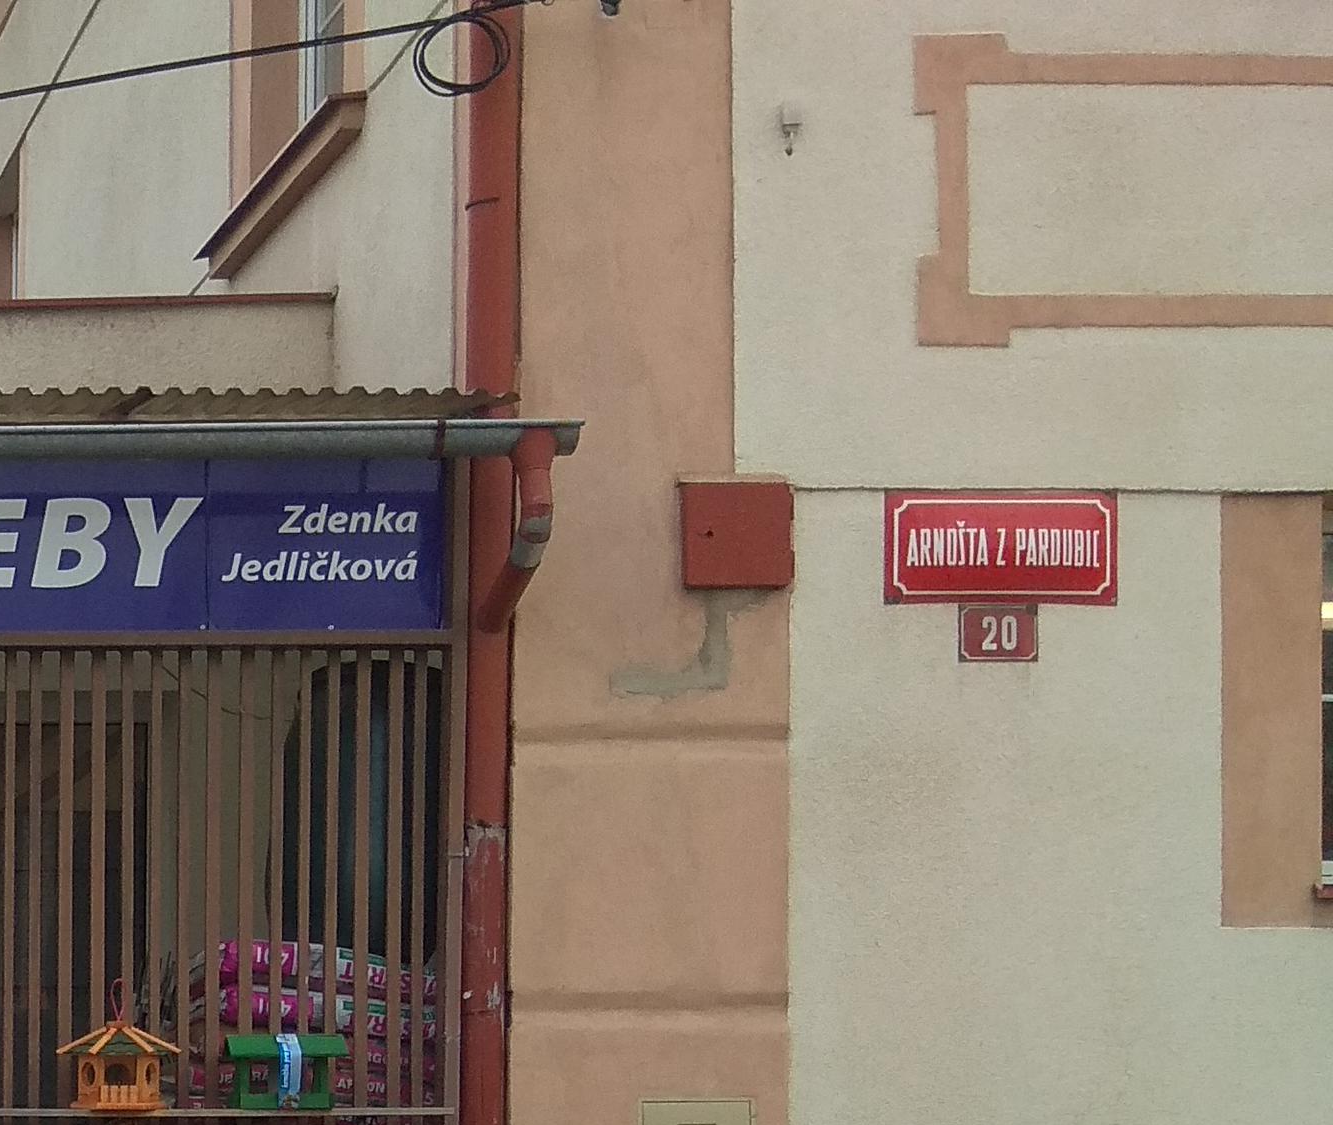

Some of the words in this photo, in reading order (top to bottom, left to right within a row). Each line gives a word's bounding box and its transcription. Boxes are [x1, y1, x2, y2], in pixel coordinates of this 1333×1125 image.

[278, 503, 419, 534] Zdenka
[906, 520, 989, 567] ARNOŠTA
[996, 528, 1007, 566] Z
[1015, 528, 1100, 568] PARDUBIC
[221, 551, 418, 582] Jedličková
[981, 615, 1018, 651] 20
